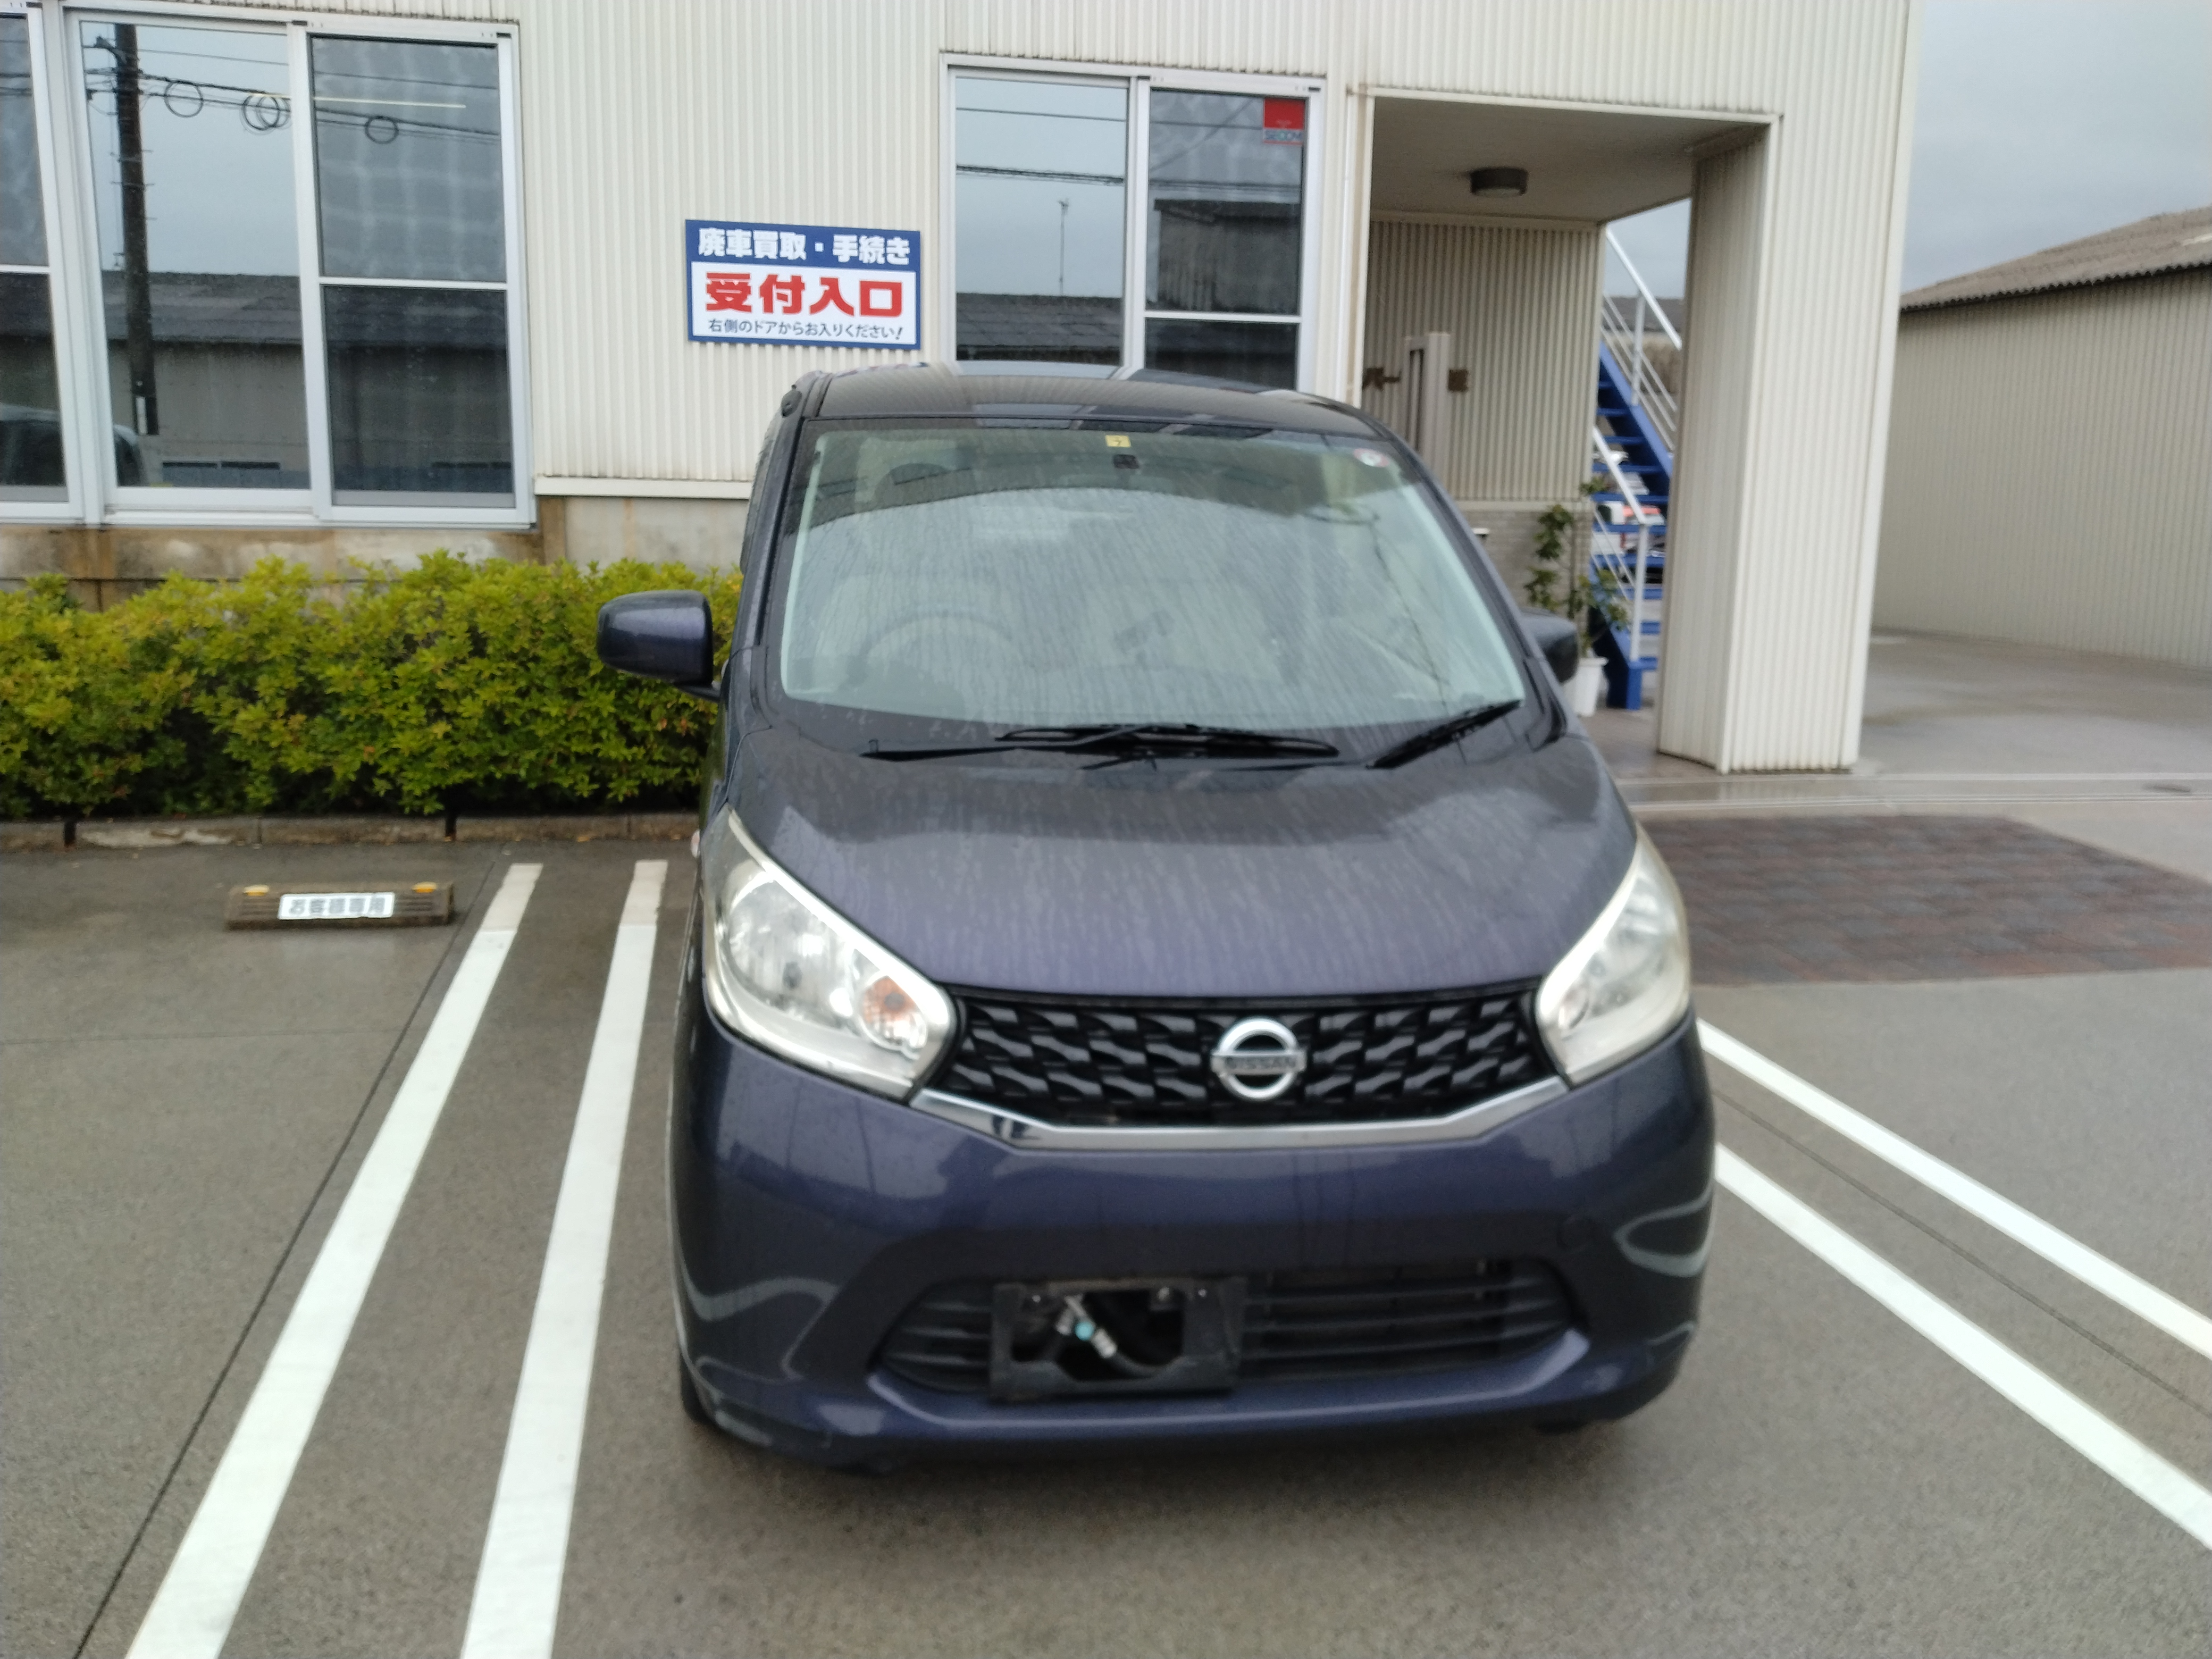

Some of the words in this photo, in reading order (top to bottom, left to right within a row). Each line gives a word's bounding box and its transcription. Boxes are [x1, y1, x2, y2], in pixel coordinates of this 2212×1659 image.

[698, 228, 909, 265] 廃車買取・手続き
[705, 272, 903, 317] 受付入口
